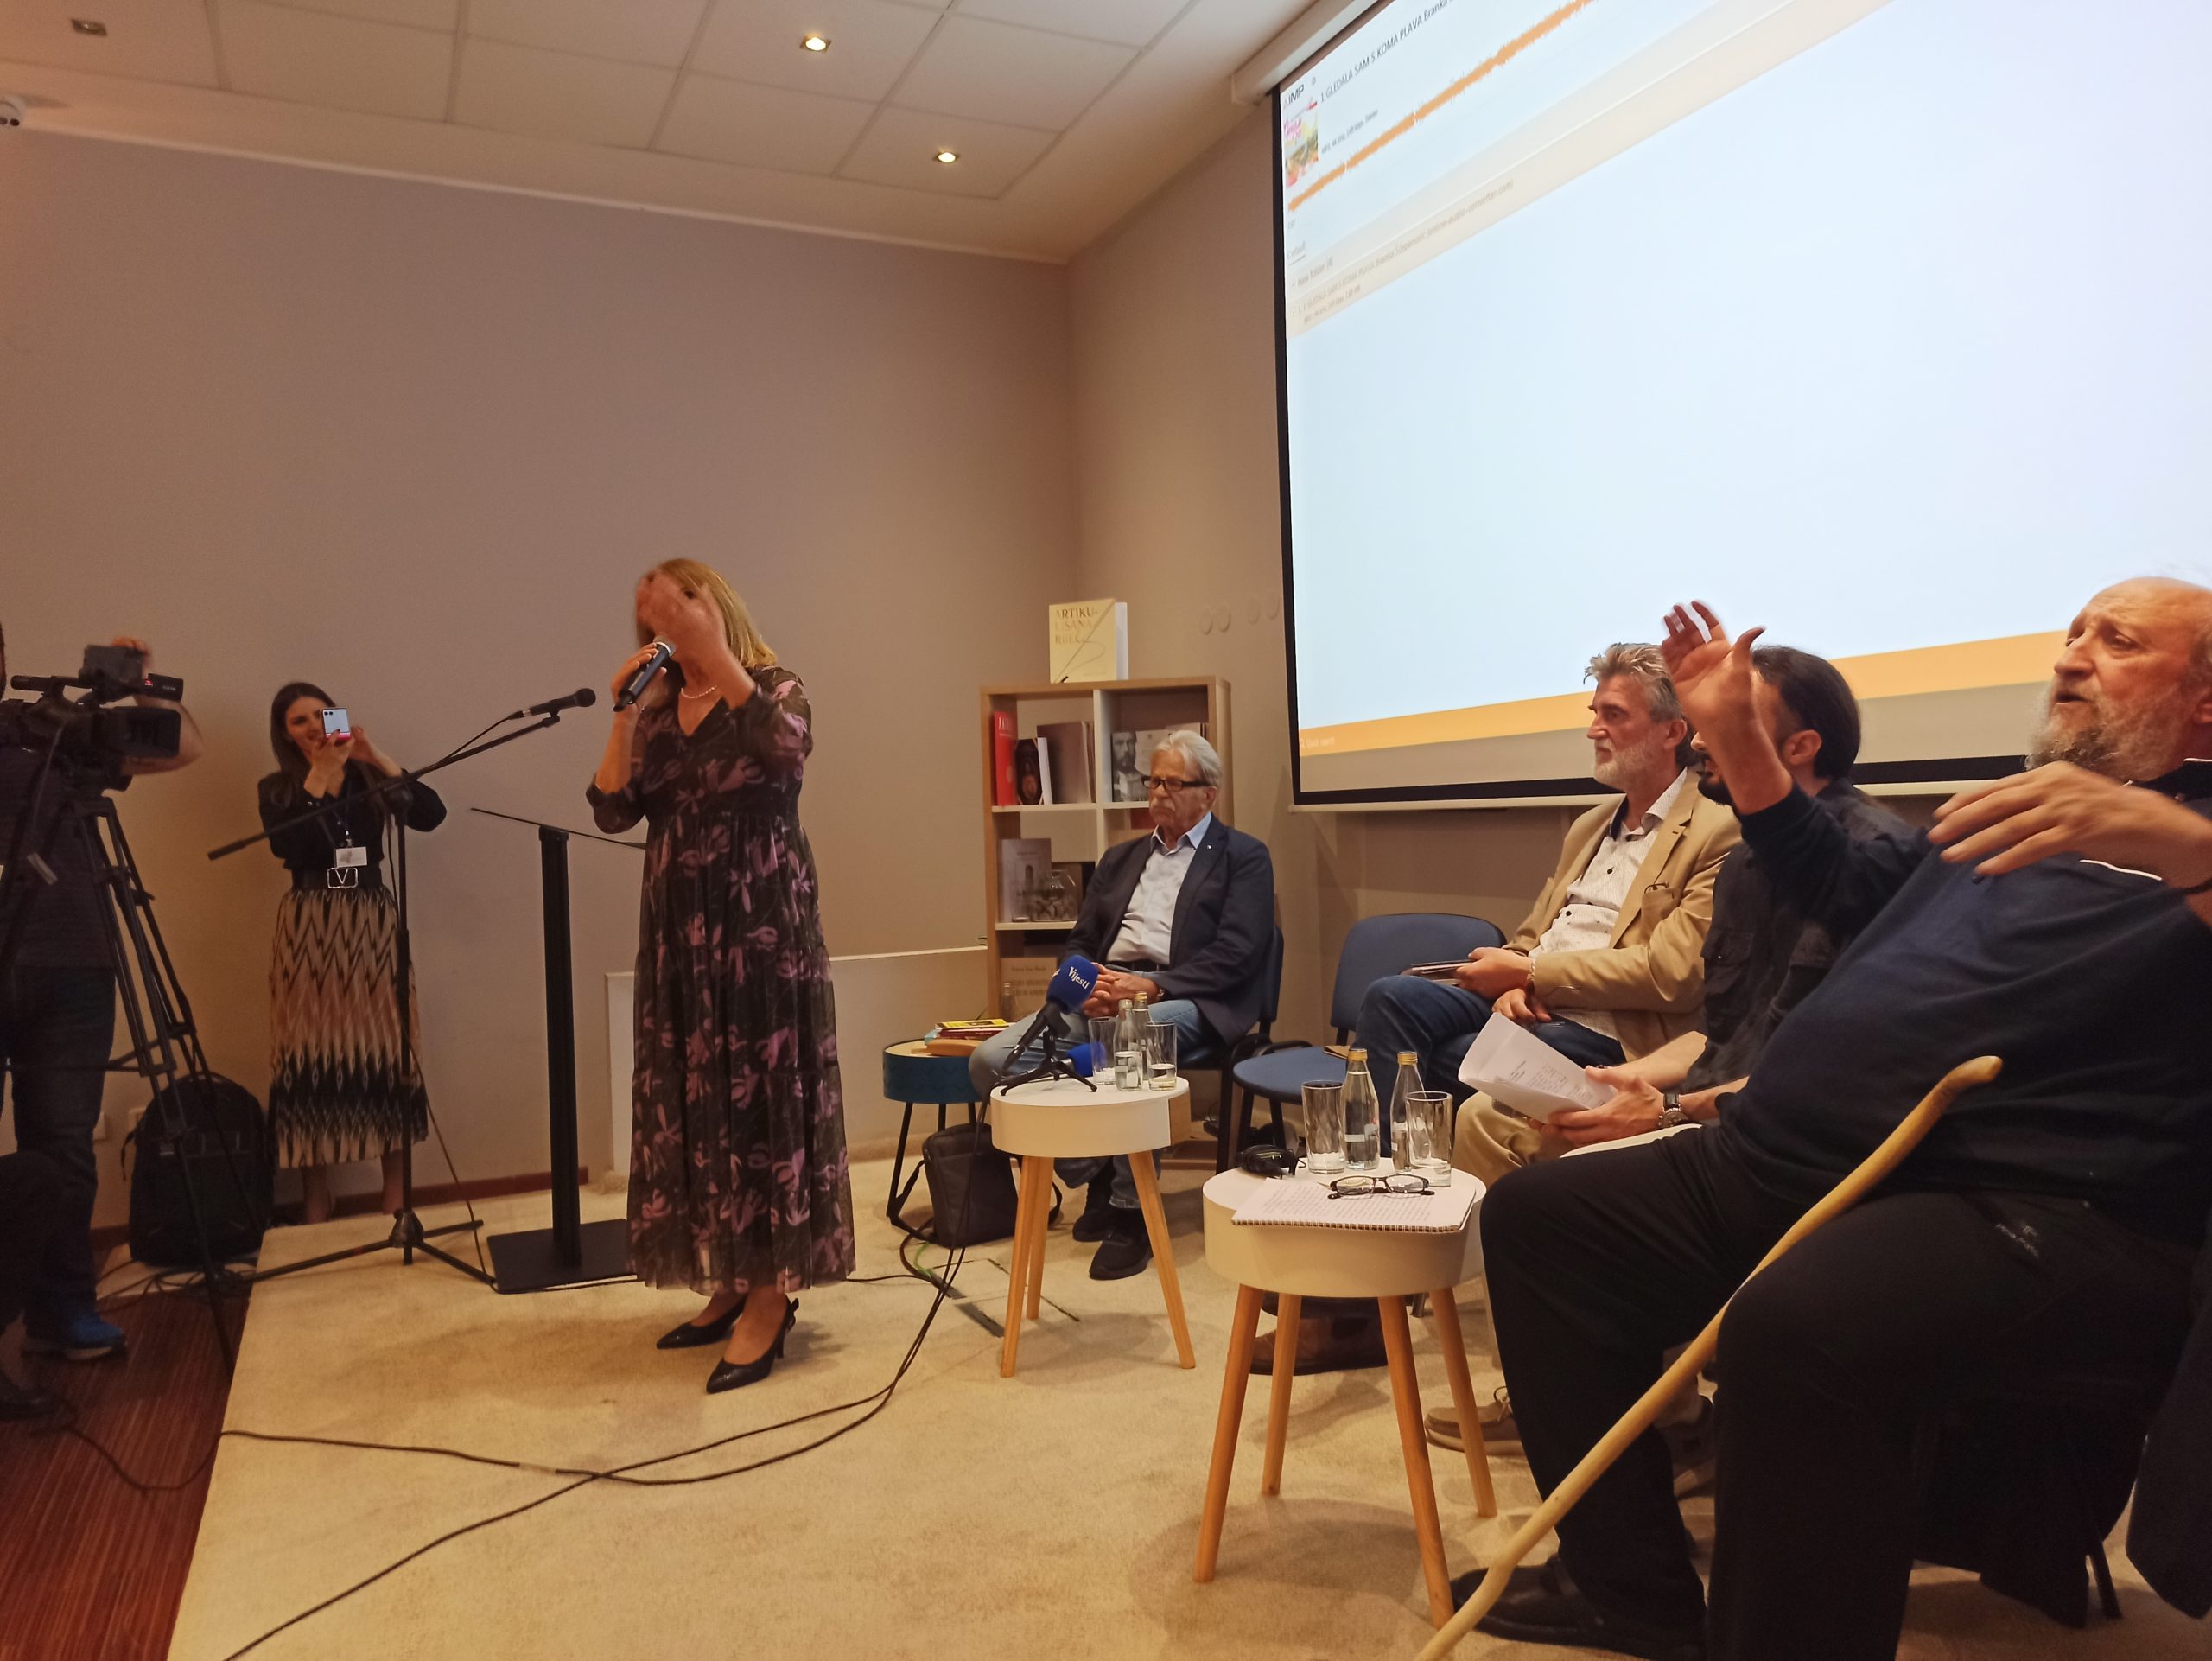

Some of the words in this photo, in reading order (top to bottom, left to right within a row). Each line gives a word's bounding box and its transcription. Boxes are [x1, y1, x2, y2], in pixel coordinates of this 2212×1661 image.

[1354, 57, 1370, 76] SAM
[1376, 35, 1399, 60] KOMA
[1400, 16, 1422, 41] PLAVA
[1068, 966, 1090, 990] Vijesti
